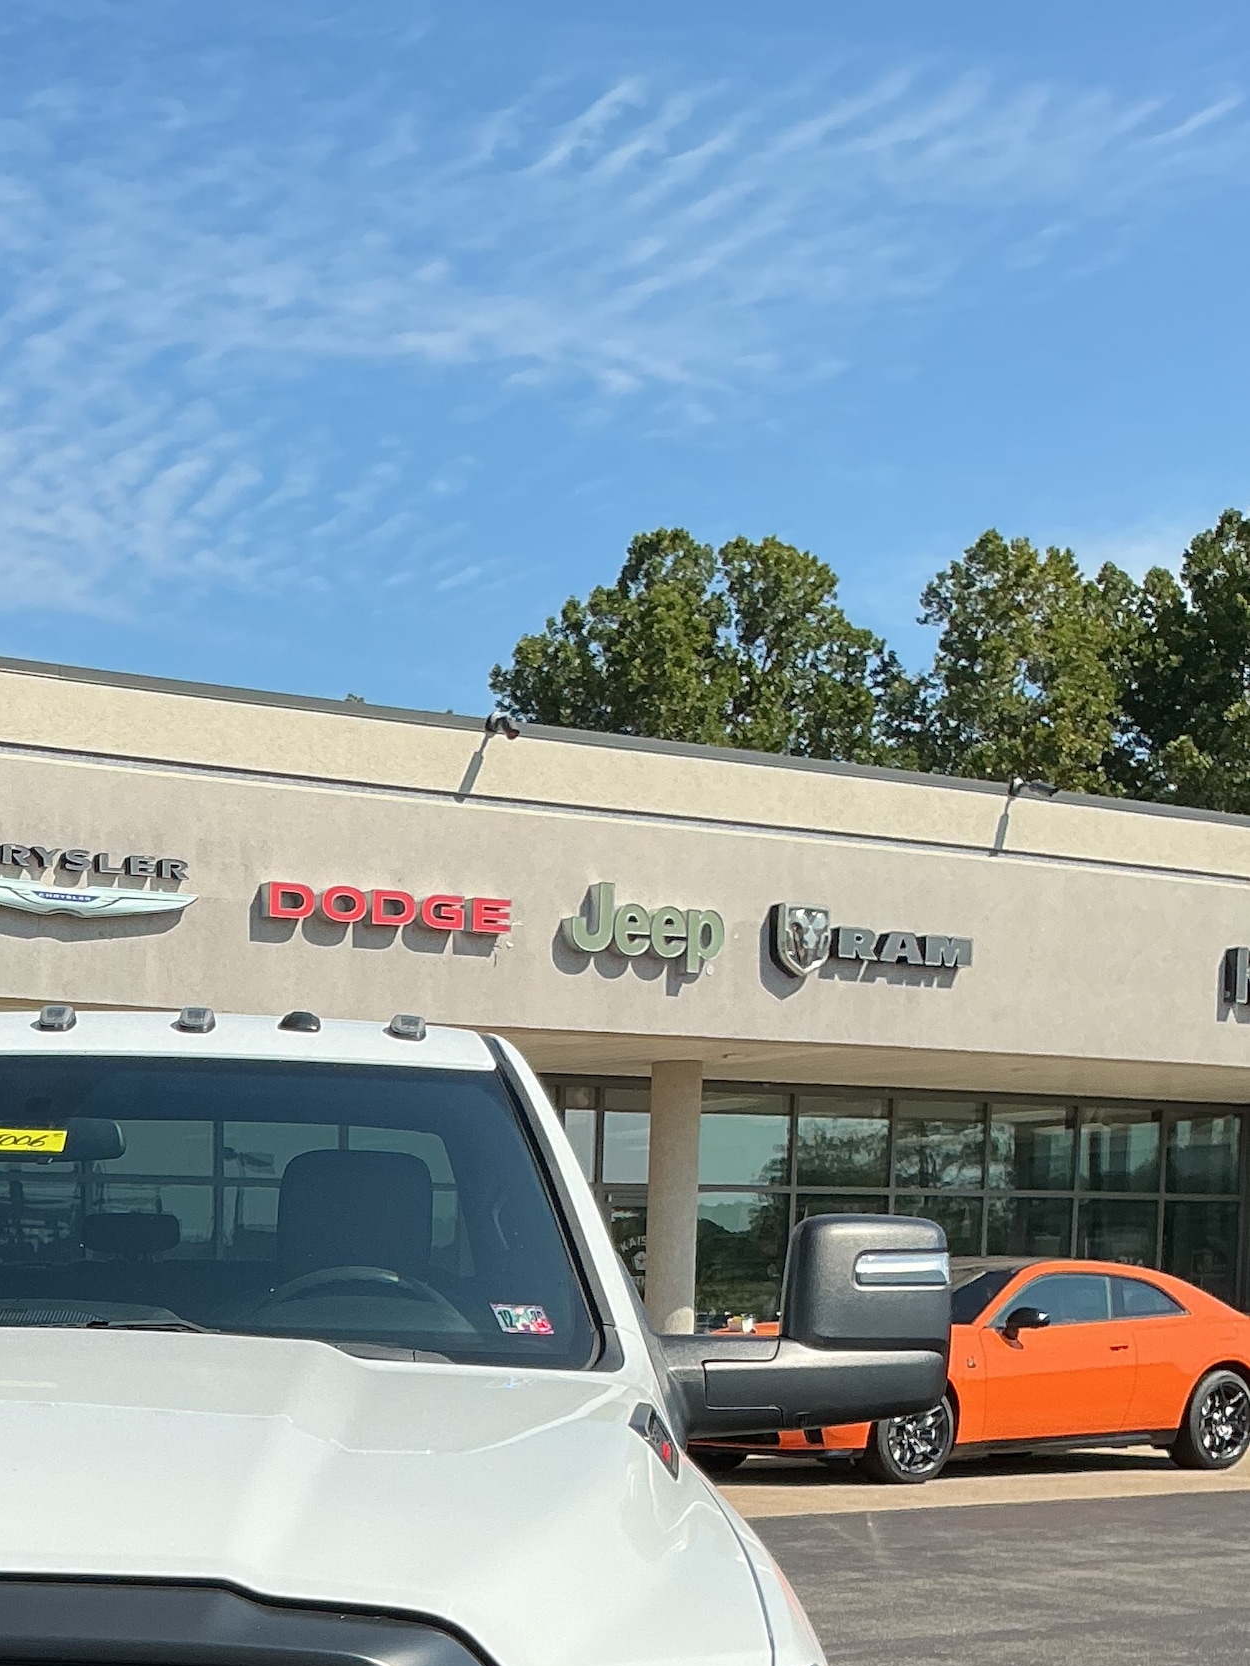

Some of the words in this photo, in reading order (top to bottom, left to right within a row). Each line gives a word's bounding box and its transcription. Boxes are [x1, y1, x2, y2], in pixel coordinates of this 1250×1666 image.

[261, 881, 513, 935] DODGE
[569, 882, 725, 972] Jeep
[832, 927, 974, 968] RAM
